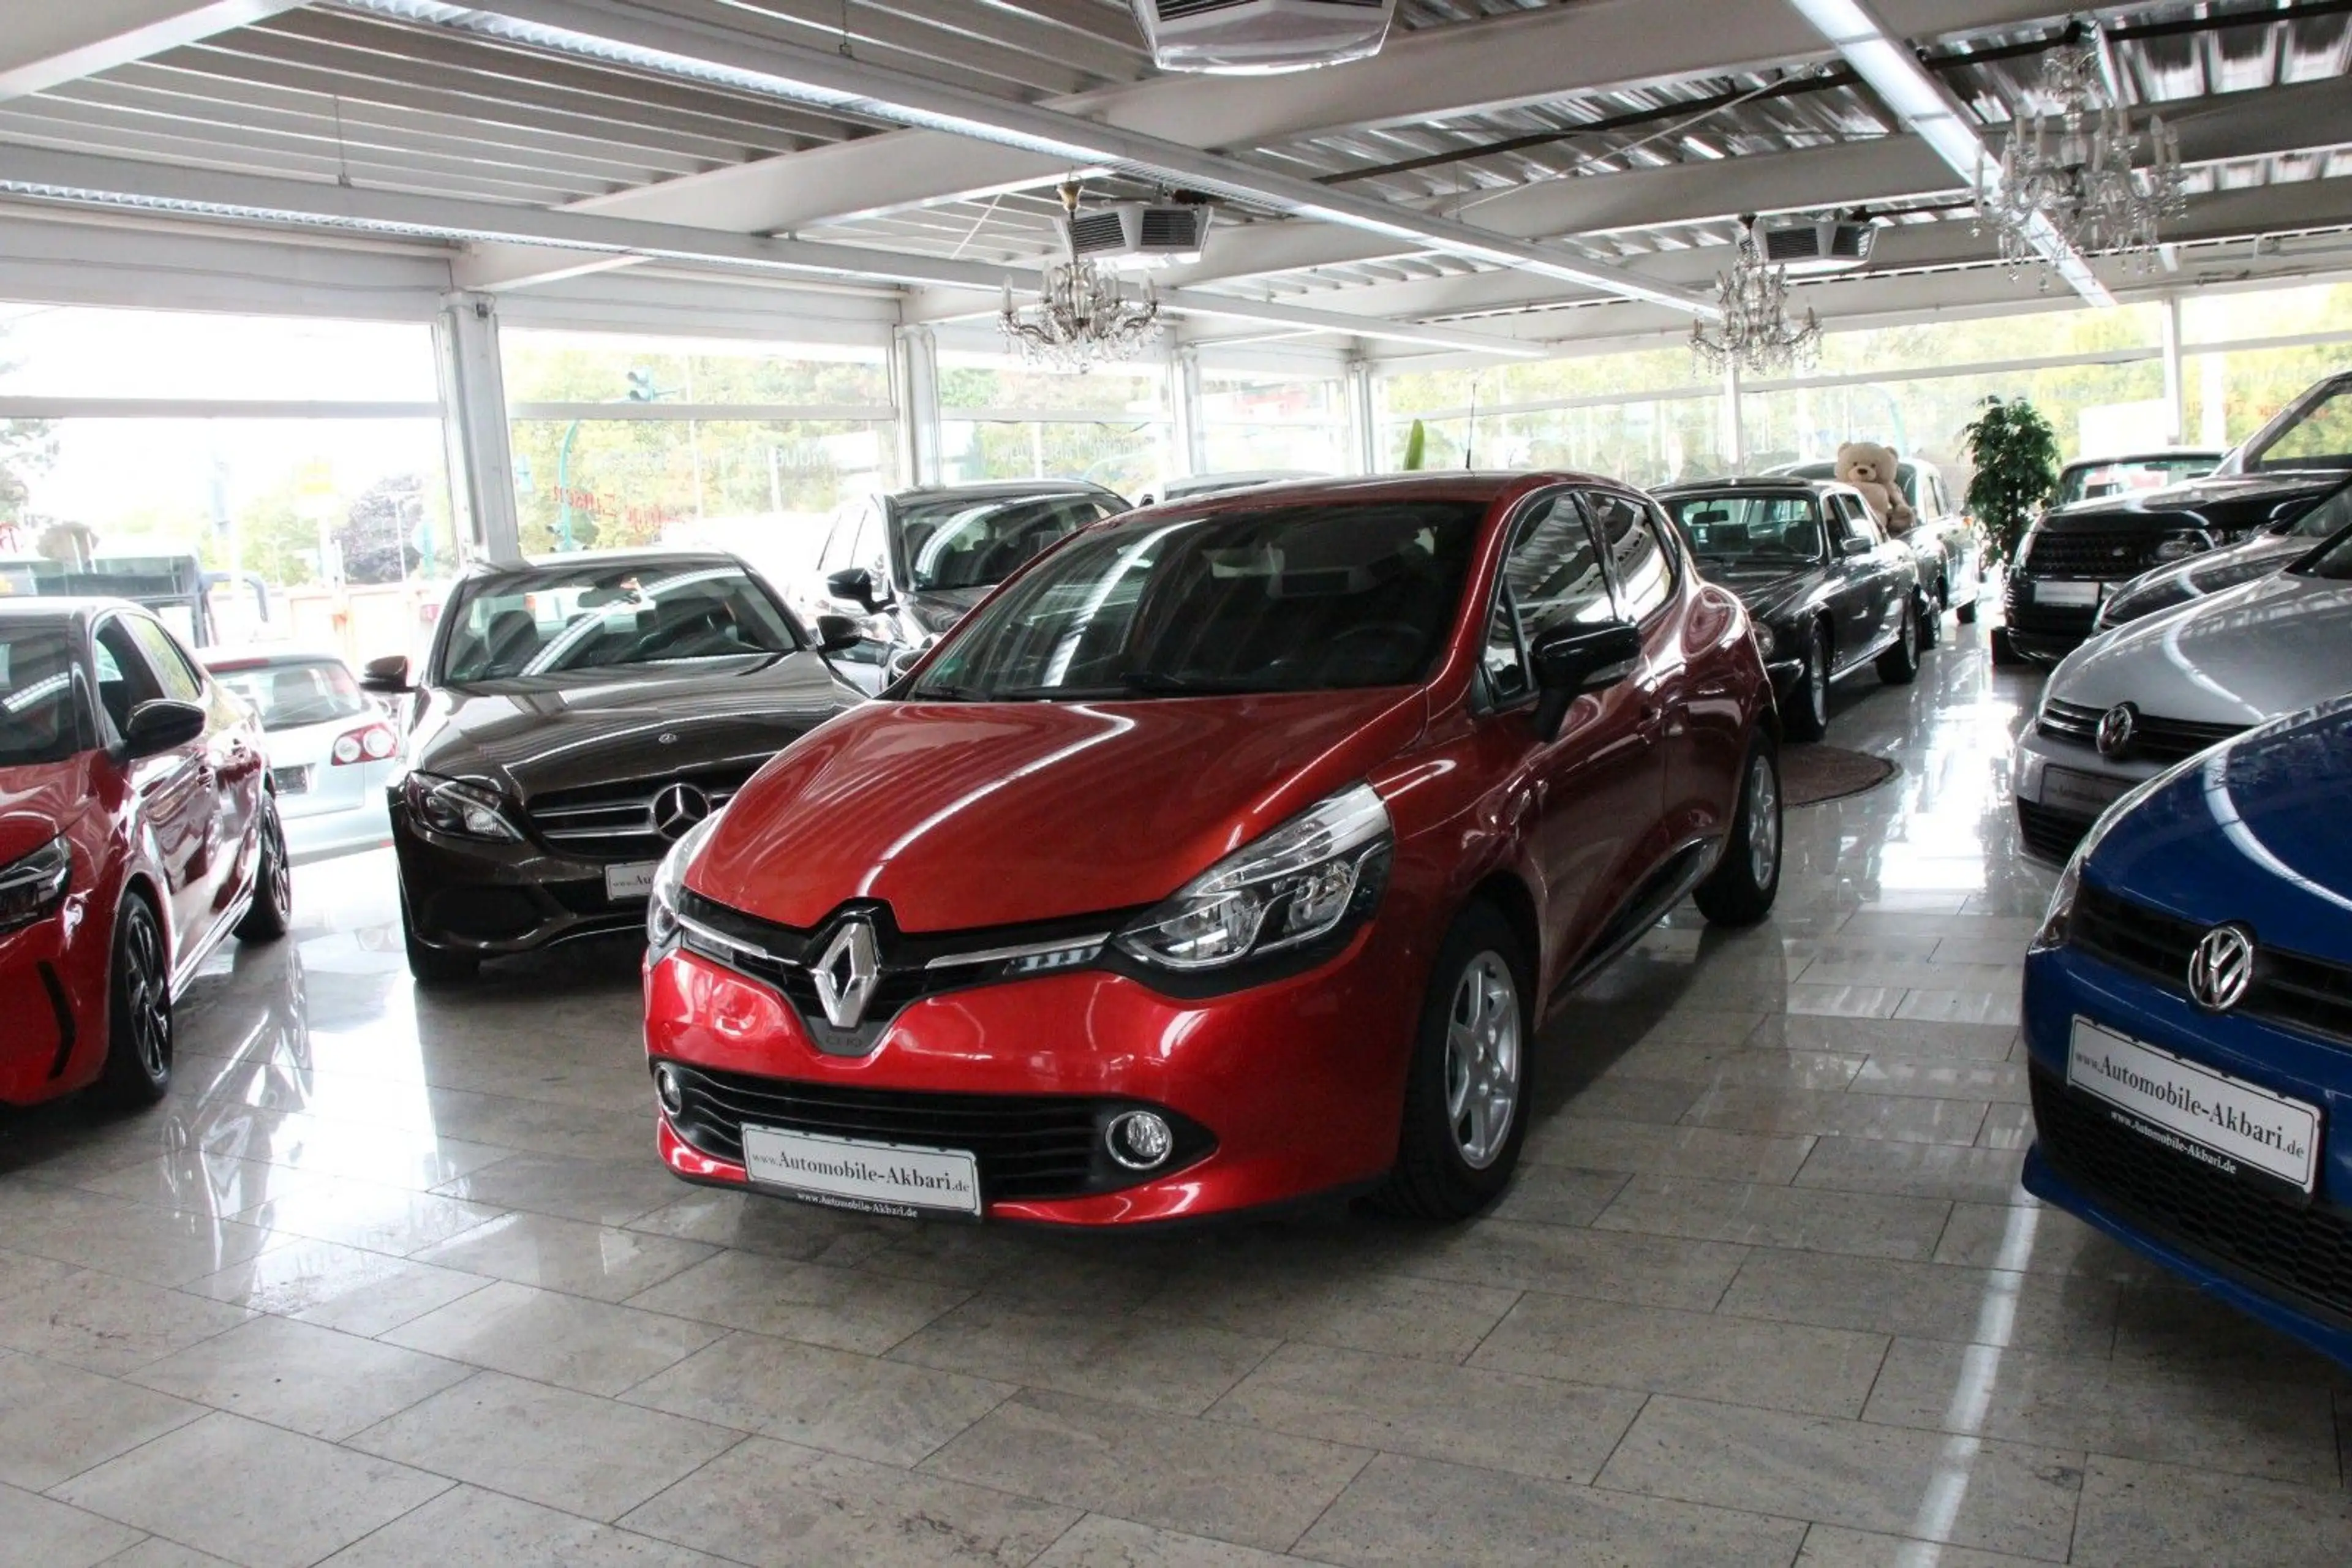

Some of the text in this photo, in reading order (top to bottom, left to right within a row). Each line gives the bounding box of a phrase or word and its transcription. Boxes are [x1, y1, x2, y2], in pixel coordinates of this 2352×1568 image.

[2075, 1052, 2304, 1158] www.Automobile-Akbari.de
[2111, 1111, 2236, 1174] www.Automobile-Akbari.de
[752, 1152, 970, 1193] www.Automobile-Akbari.de
[797, 1193, 918, 1218] www.Automobile-Akbari.de
